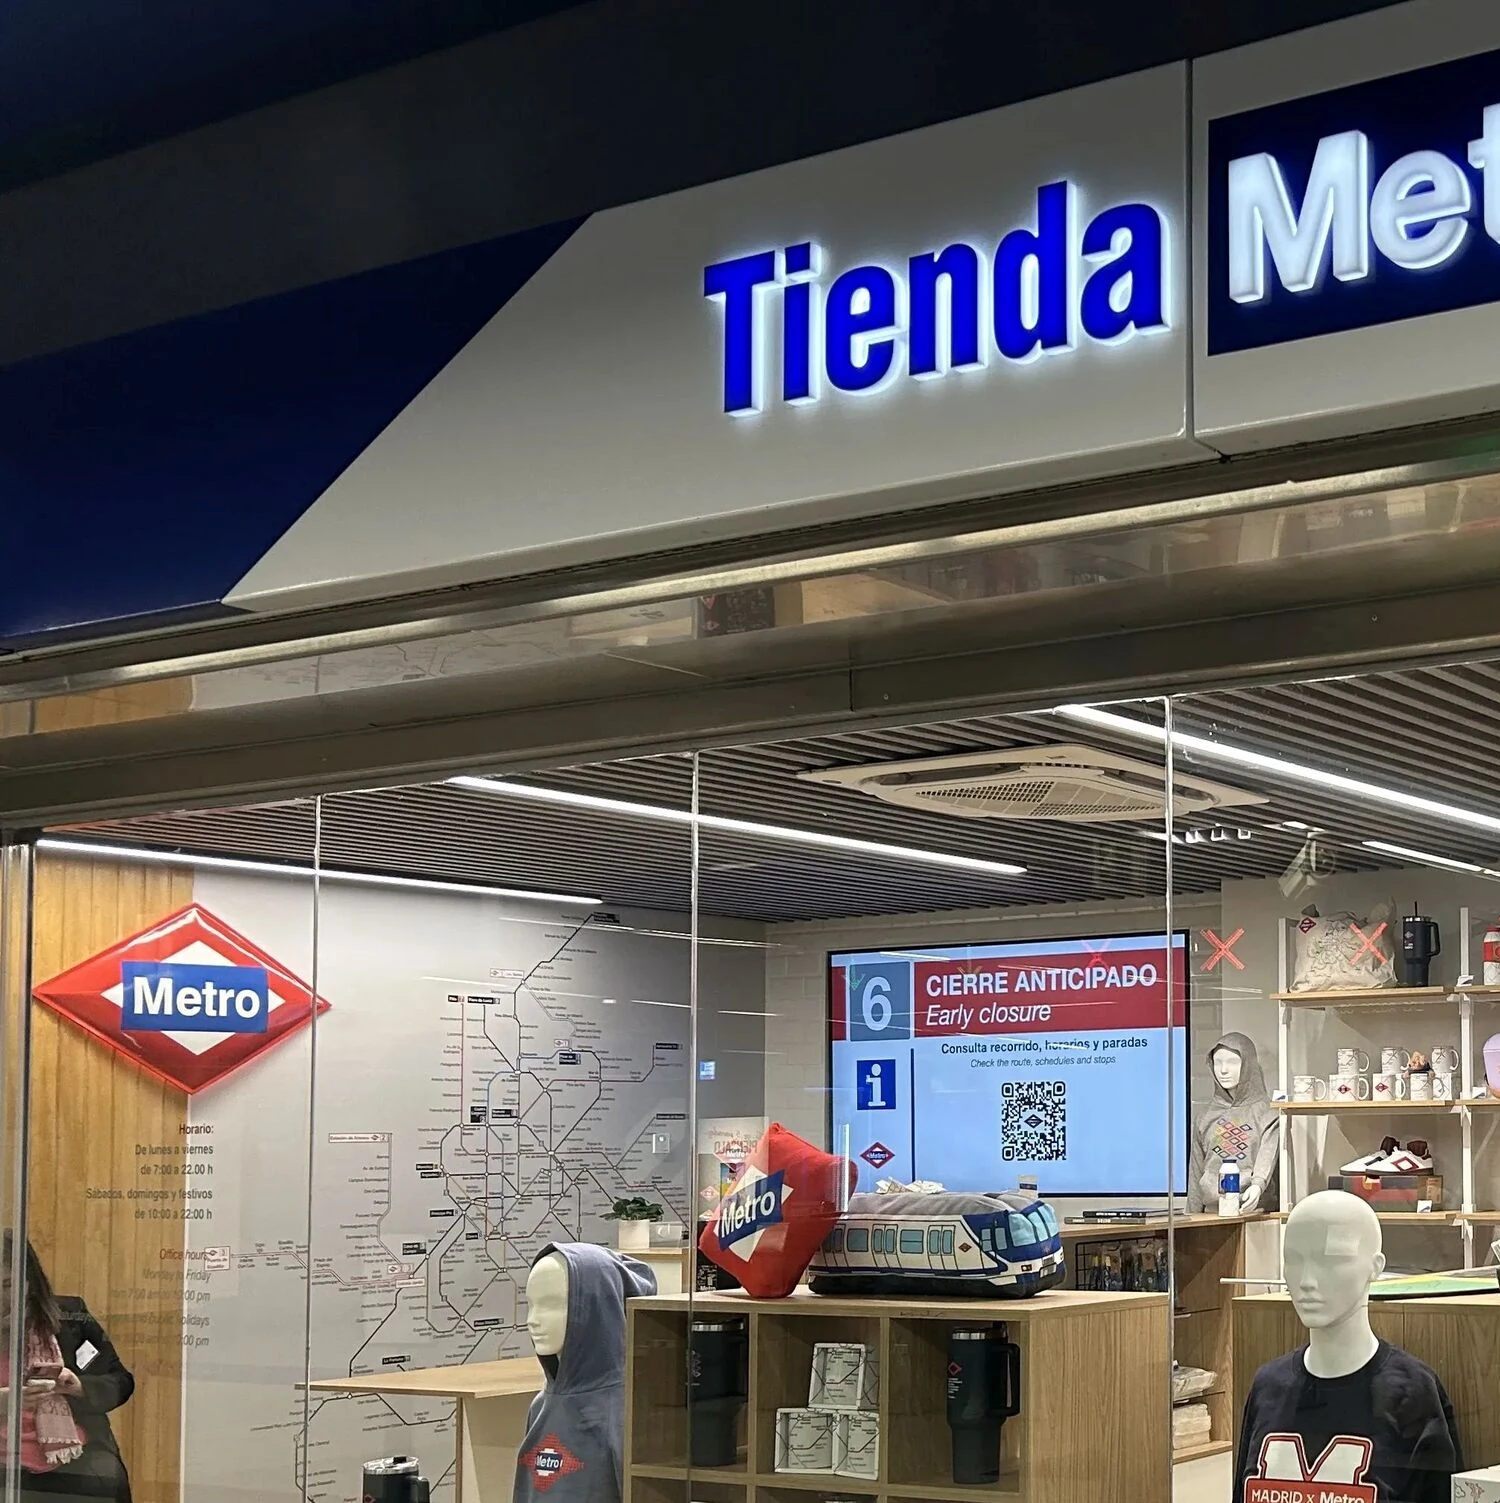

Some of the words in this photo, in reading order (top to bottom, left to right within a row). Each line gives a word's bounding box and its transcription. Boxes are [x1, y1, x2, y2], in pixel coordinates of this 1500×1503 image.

[703, 179, 1168, 416] Tienda
[926, 972, 1010, 997] CIERRE
[1014, 963, 1158, 992] ANTICIPADO
[133, 976, 260, 1018] Metro
[862, 976, 893, 1032] 6
[926, 1003, 975, 1030] Early
[979, 1003, 1052, 1024] closure
[941, 1042, 988, 1054] Consulta
[990, 1040, 1042, 1053] recorrido,
[1044, 1039, 1090, 1051] horarios
[1092, 1040, 1099, 1052] y
[1101, 1037, 1148, 1051] paradas
[970, 1058, 995, 1068] Check
[996, 1057, 1010, 1067] the
[1011, 1057, 1033, 1068] route,
[1035, 1056, 1075, 1067] schedules
[1076, 1055, 1092, 1065] and
[1093, 1054, 1117, 1066] stops
[179, 1123, 214, 1135] Horario:
[135, 1144, 147, 1155] De
[149, 1144, 172, 1155] lunes
[174, 1147, 179, 1155] a
[182, 1144, 214, 1155] viernes
[140, 1164, 151, 1175] de
[153, 1164, 172, 1175] 7:00
[207, 1163, 213, 1174] h
[127, 1188, 168, 1201] domingos
[171, 1190, 176, 1201] y
[178, 1188, 213, 1200] festivos
[134, 1208, 145, 1219] de
[148, 1208, 171, 1219] 10:00
[206, 1208, 212, 1219] h
[721, 1191, 776, 1239] Metro
[159, 1249, 183, 1260] Office
[186, 1269, 212, 1284] Friday
[178, 1314, 210, 1330] olidays
[1251, 1489, 1303, 1503] MADRID
[1320, 1491, 1364, 1503] Metro
